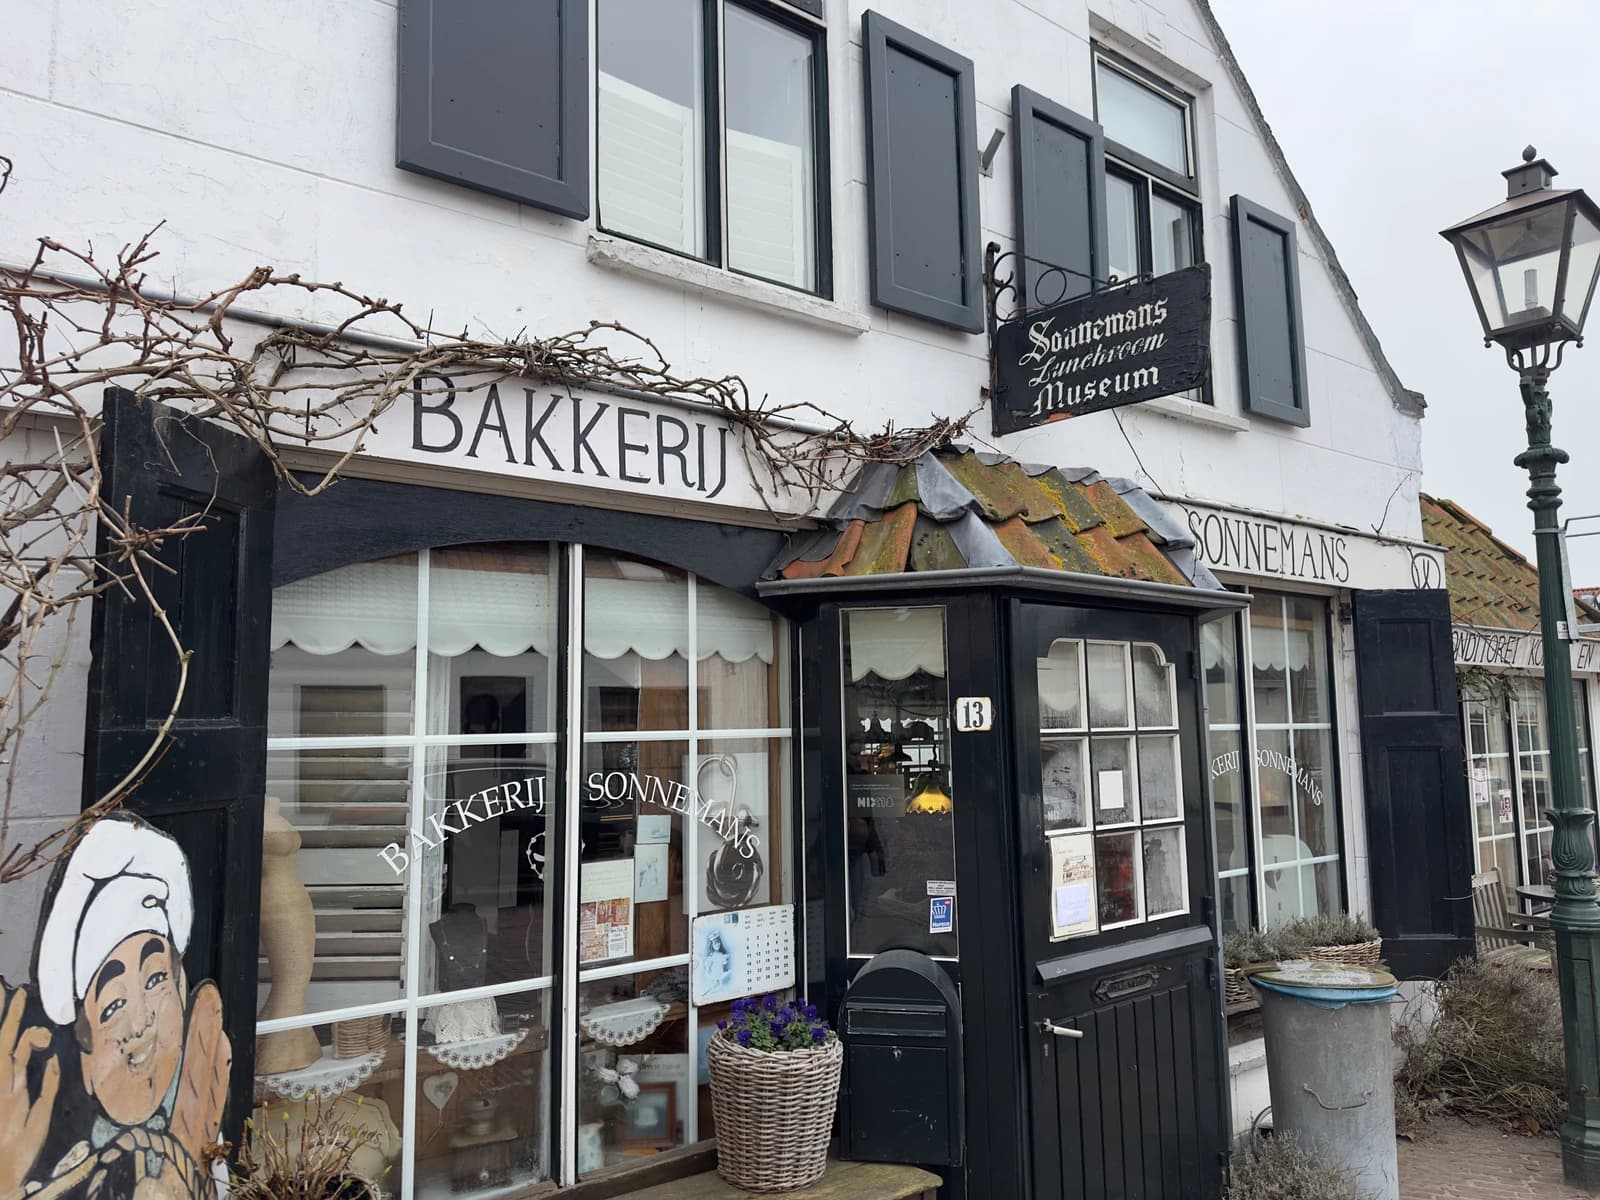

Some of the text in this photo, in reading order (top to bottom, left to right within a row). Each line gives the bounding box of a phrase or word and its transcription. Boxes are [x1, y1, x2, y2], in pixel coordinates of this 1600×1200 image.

[1028, 333, 1168, 387] Lunchroom
[1030, 366, 1159, 418] Museum
[412, 371, 728, 498] BAKKERIJ
[1188, 511, 1349, 583] SONNEMANS
[962, 701, 984, 729] 13
[1211, 750, 1240, 780] KERIJ
[377, 776, 546, 876] BAKKERIJ
[588, 771, 761, 860] SONNEMANS
